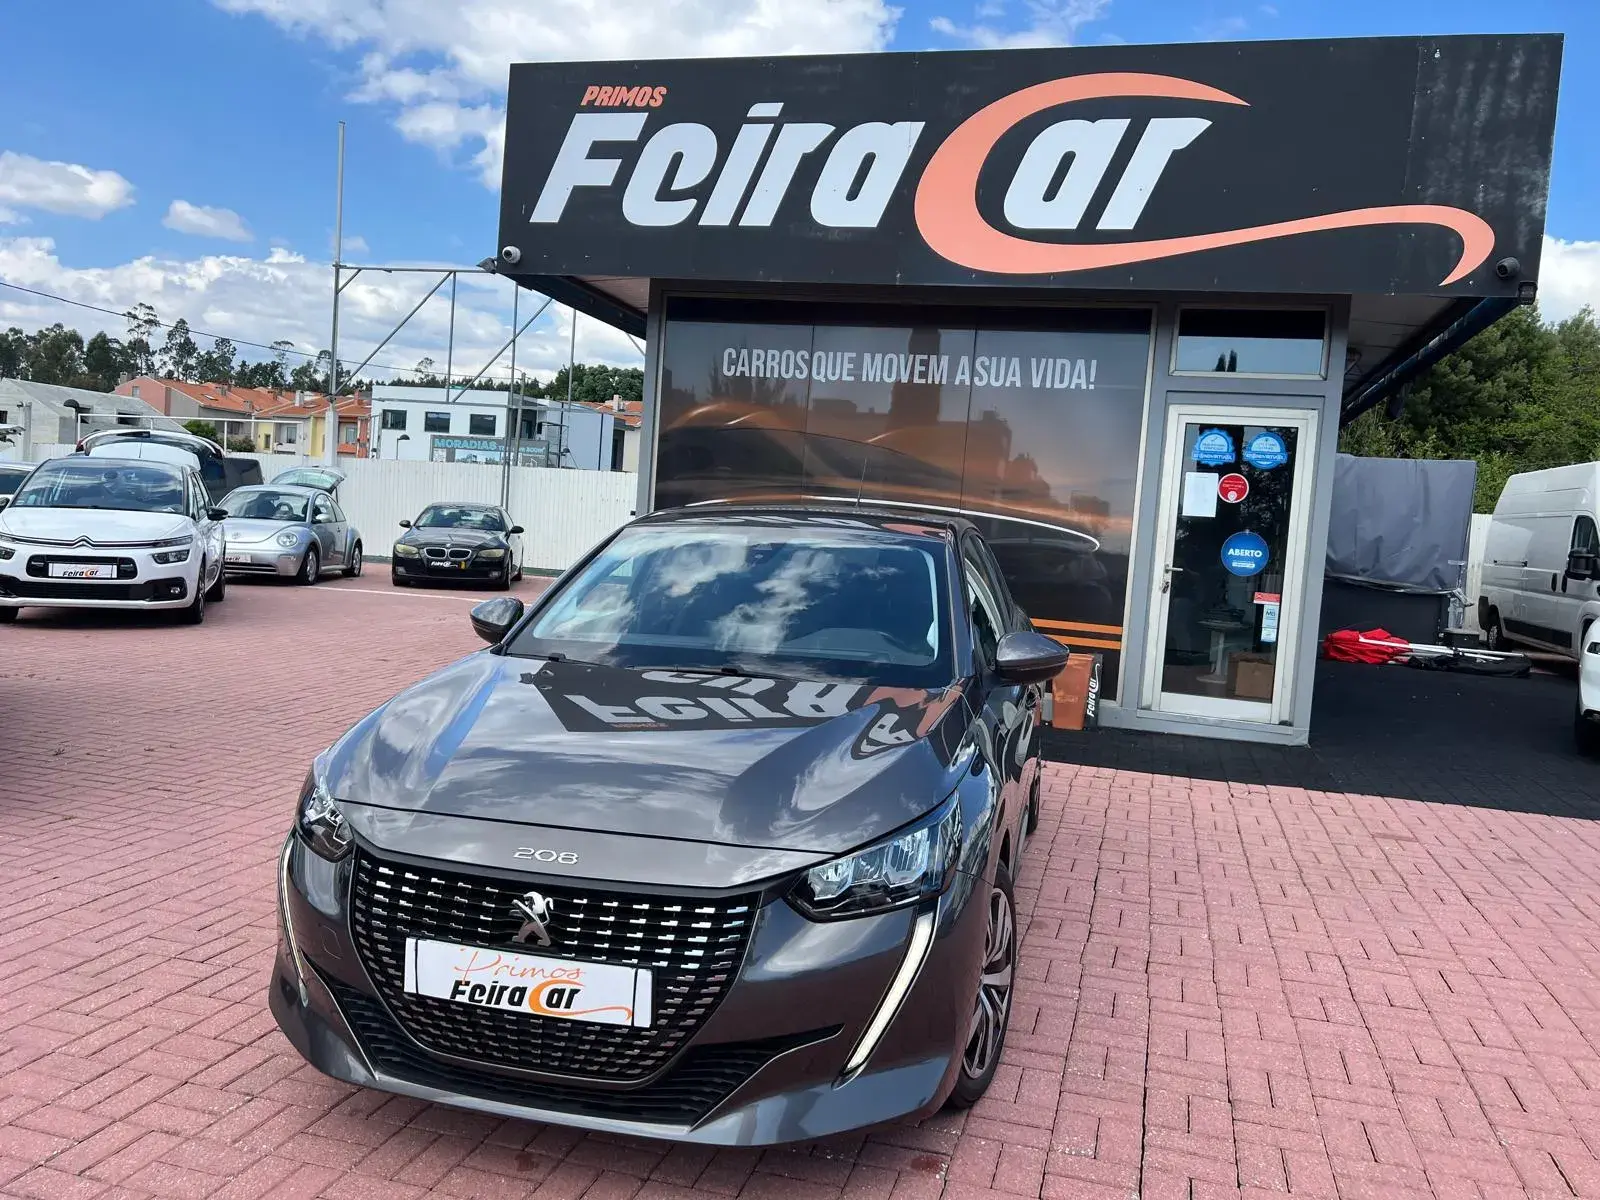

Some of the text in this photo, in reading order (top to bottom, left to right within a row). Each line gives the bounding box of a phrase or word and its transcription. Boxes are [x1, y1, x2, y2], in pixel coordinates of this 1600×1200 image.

[580, 86, 667, 108] PRIMOS
[723, 347, 1098, 390] CARROS QUE MOVEM A SUA VIDA!
[434, 438, 497, 450] MORADIAS
[1228, 548, 1262, 558] ABERTO
[513, 847, 579, 865] 208
[454, 948, 586, 984] Primos
